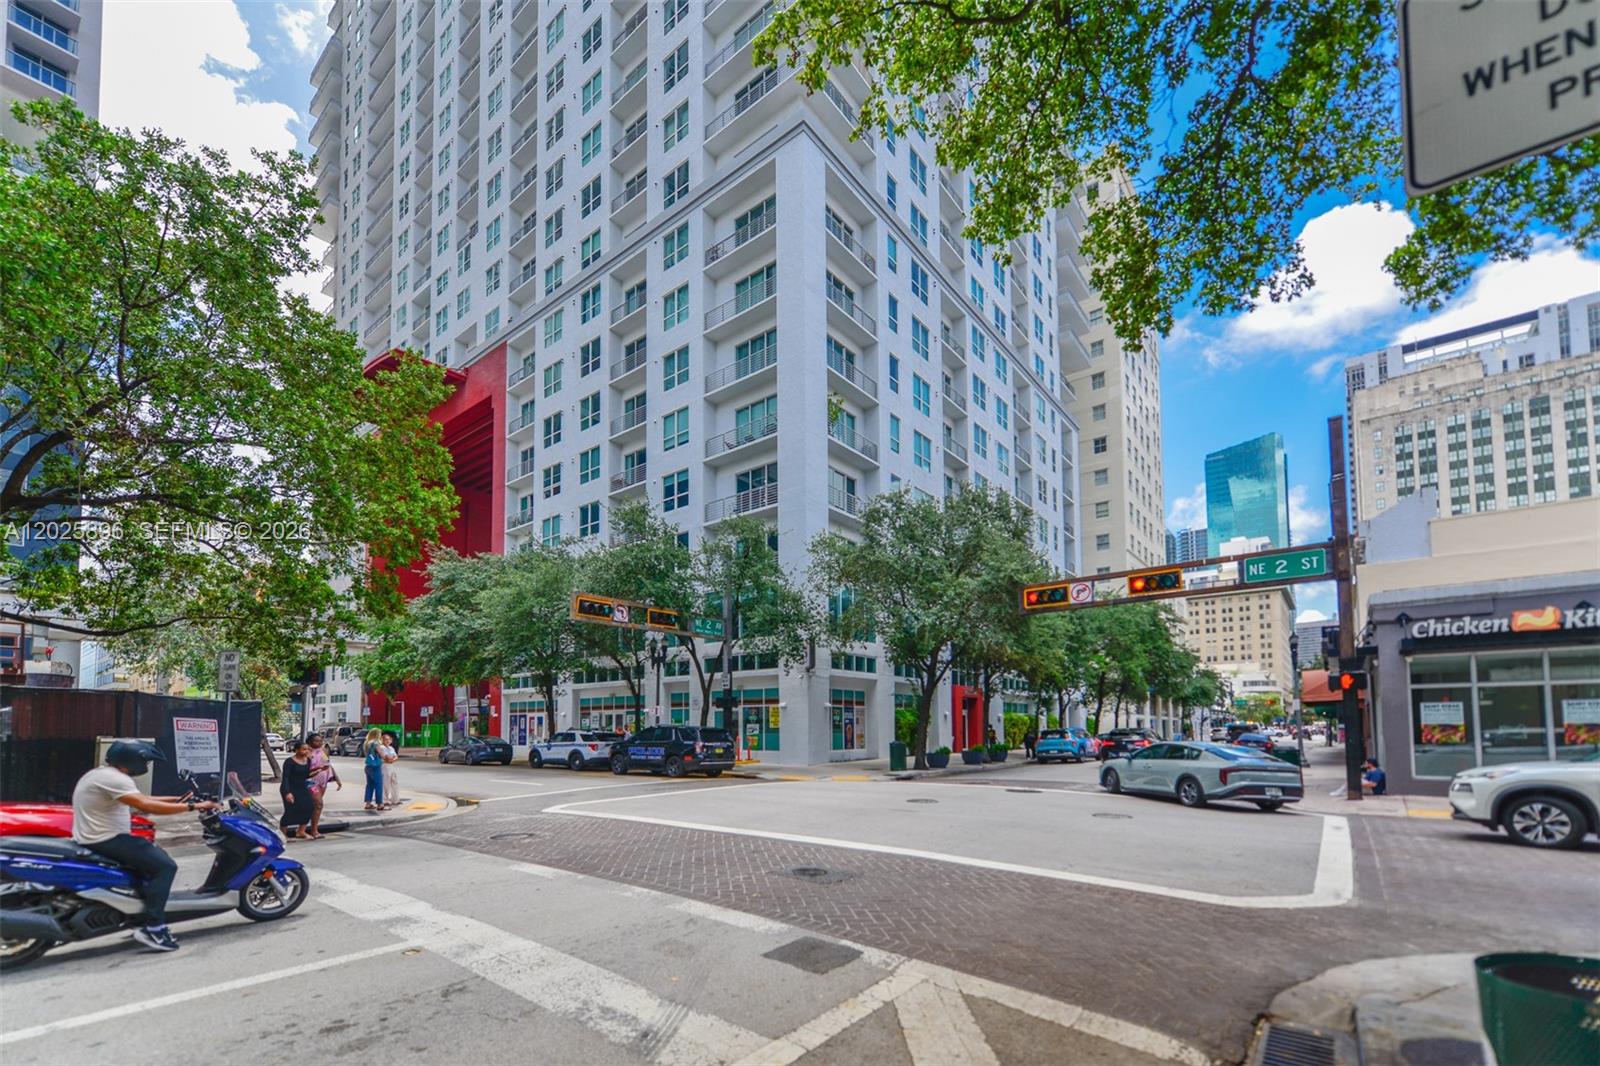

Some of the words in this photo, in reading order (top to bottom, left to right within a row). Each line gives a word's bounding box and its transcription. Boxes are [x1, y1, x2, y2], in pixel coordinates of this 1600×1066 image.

[1462, 20, 1596, 97] WHEN
[1249, 563, 1266, 576] NE
[1275, 560, 1288, 574] 2
[1301, 556, 1319, 570] ST
[1411, 615, 1510, 638] Chicken
[224, 653, 236, 663] NO
